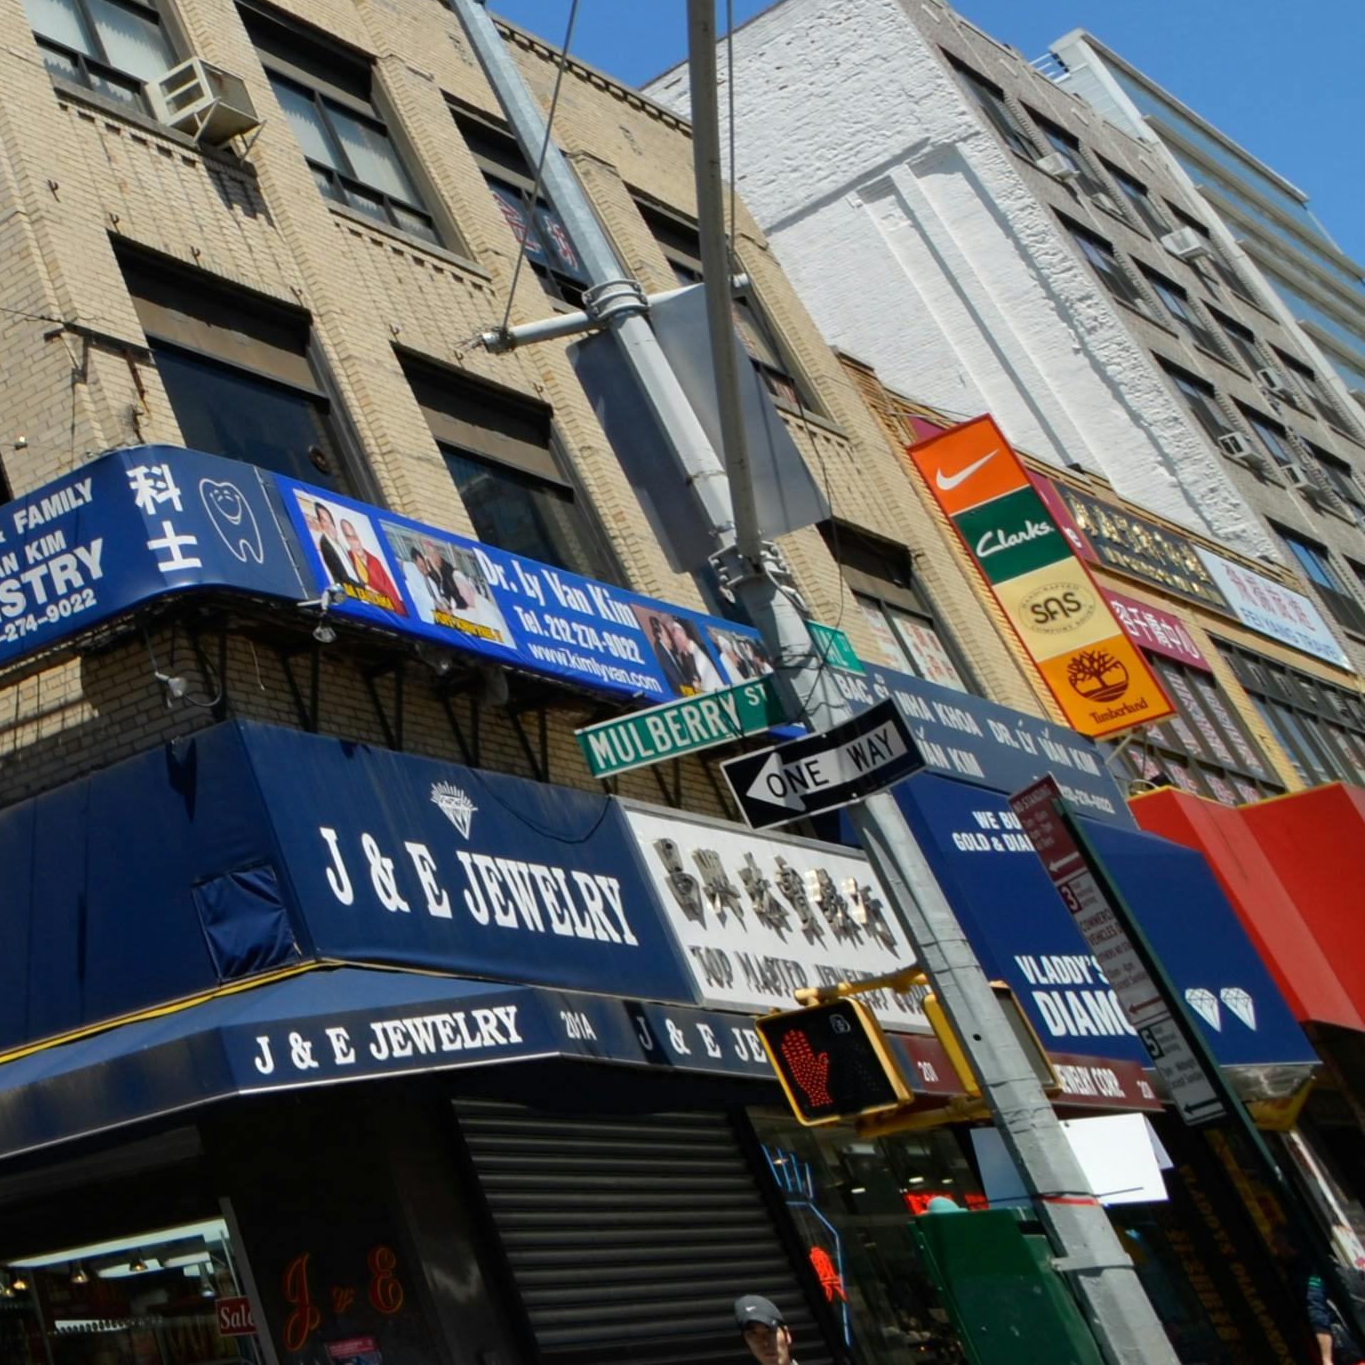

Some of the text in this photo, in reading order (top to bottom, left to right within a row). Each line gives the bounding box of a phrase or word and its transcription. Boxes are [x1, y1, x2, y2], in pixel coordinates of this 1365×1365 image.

[13, 478, 93, 534] FAMILY
[25, 530, 67, 565] KIM
[976, 520, 1055, 558] Clarks
[472, 546, 640, 630] Dr. Ly Van Kim
[1030, 592, 1082, 625] SAS
[528, 642, 663, 693] www.kimlyvan.com
[588, 685, 767, 771] MULBERRY ST
[1090, 697, 1149, 726] Timberland
[895, 690, 936, 723] NHA
[933, 701, 983, 737] KHOA
[1069, 747, 1101, 777] KIM
[765, 729, 899, 798] ONE WAY
[948, 747, 985, 778] KIM
[972, 811, 999, 829] WE
[999, 812, 1023, 830] BU
[952, 833, 991, 851] GOLD
[991, 836, 1005, 852] &
[320, 827, 354, 906] J
[361, 832, 411, 913] &
[404, 841, 452, 919] E
[455, 850, 639, 946] JEWELRY
[255, 1005, 523, 1074] J & E JEWELRY
[560, 1011, 597, 1041] 201A
[636, 1016, 653, 1051] J
[665, 1019, 691, 1055] &
[696, 1023, 722, 1058] E
[918, 1061, 939, 1082] 201
